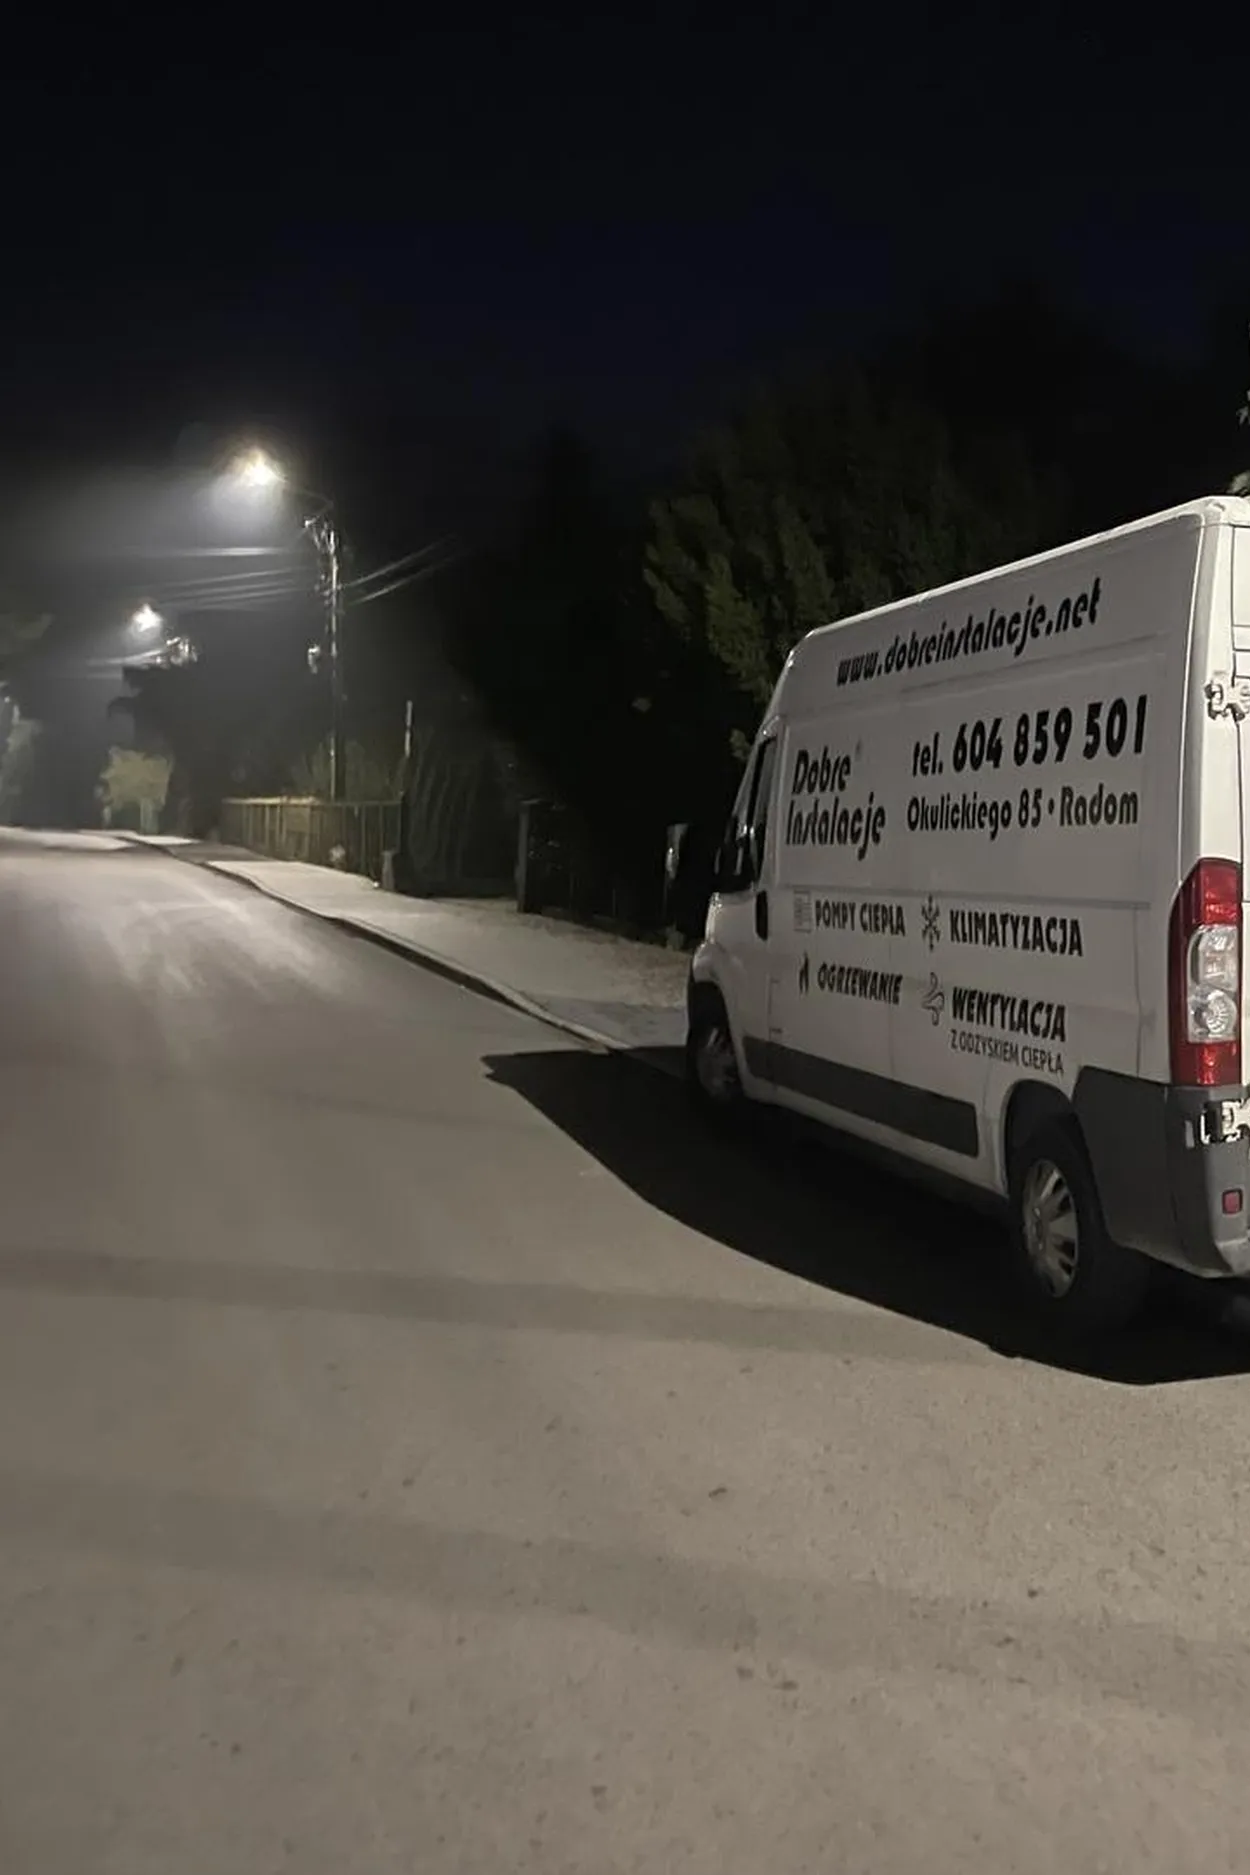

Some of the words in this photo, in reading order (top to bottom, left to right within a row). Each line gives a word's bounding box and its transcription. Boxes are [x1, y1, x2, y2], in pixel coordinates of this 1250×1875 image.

[836, 577, 1101, 686] www.dobreinstalacje.net
[912, 732, 944, 777] tel.
[952, 717, 1004, 773] 604
[1013, 707, 1072, 767] 859
[1082, 695, 1148, 760] 501
[792, 745, 851, 795] Dobre
[786, 791, 886, 861] Instalacje
[907, 793, 1011, 841] Okulickiego
[1018, 788, 1042, 829] 85
[1059, 783, 1139, 827] Radom
[815, 899, 857, 931] POMPY
[949, 909, 1084, 957] KLIMATYZACJA
[817, 961, 904, 1006] OGRZEWANIE
[952, 986, 1067, 1043] WENTYLACJA
[950, 1028, 958, 1050] Z
[959, 1031, 1019, 1066] ODZYSKIEM
